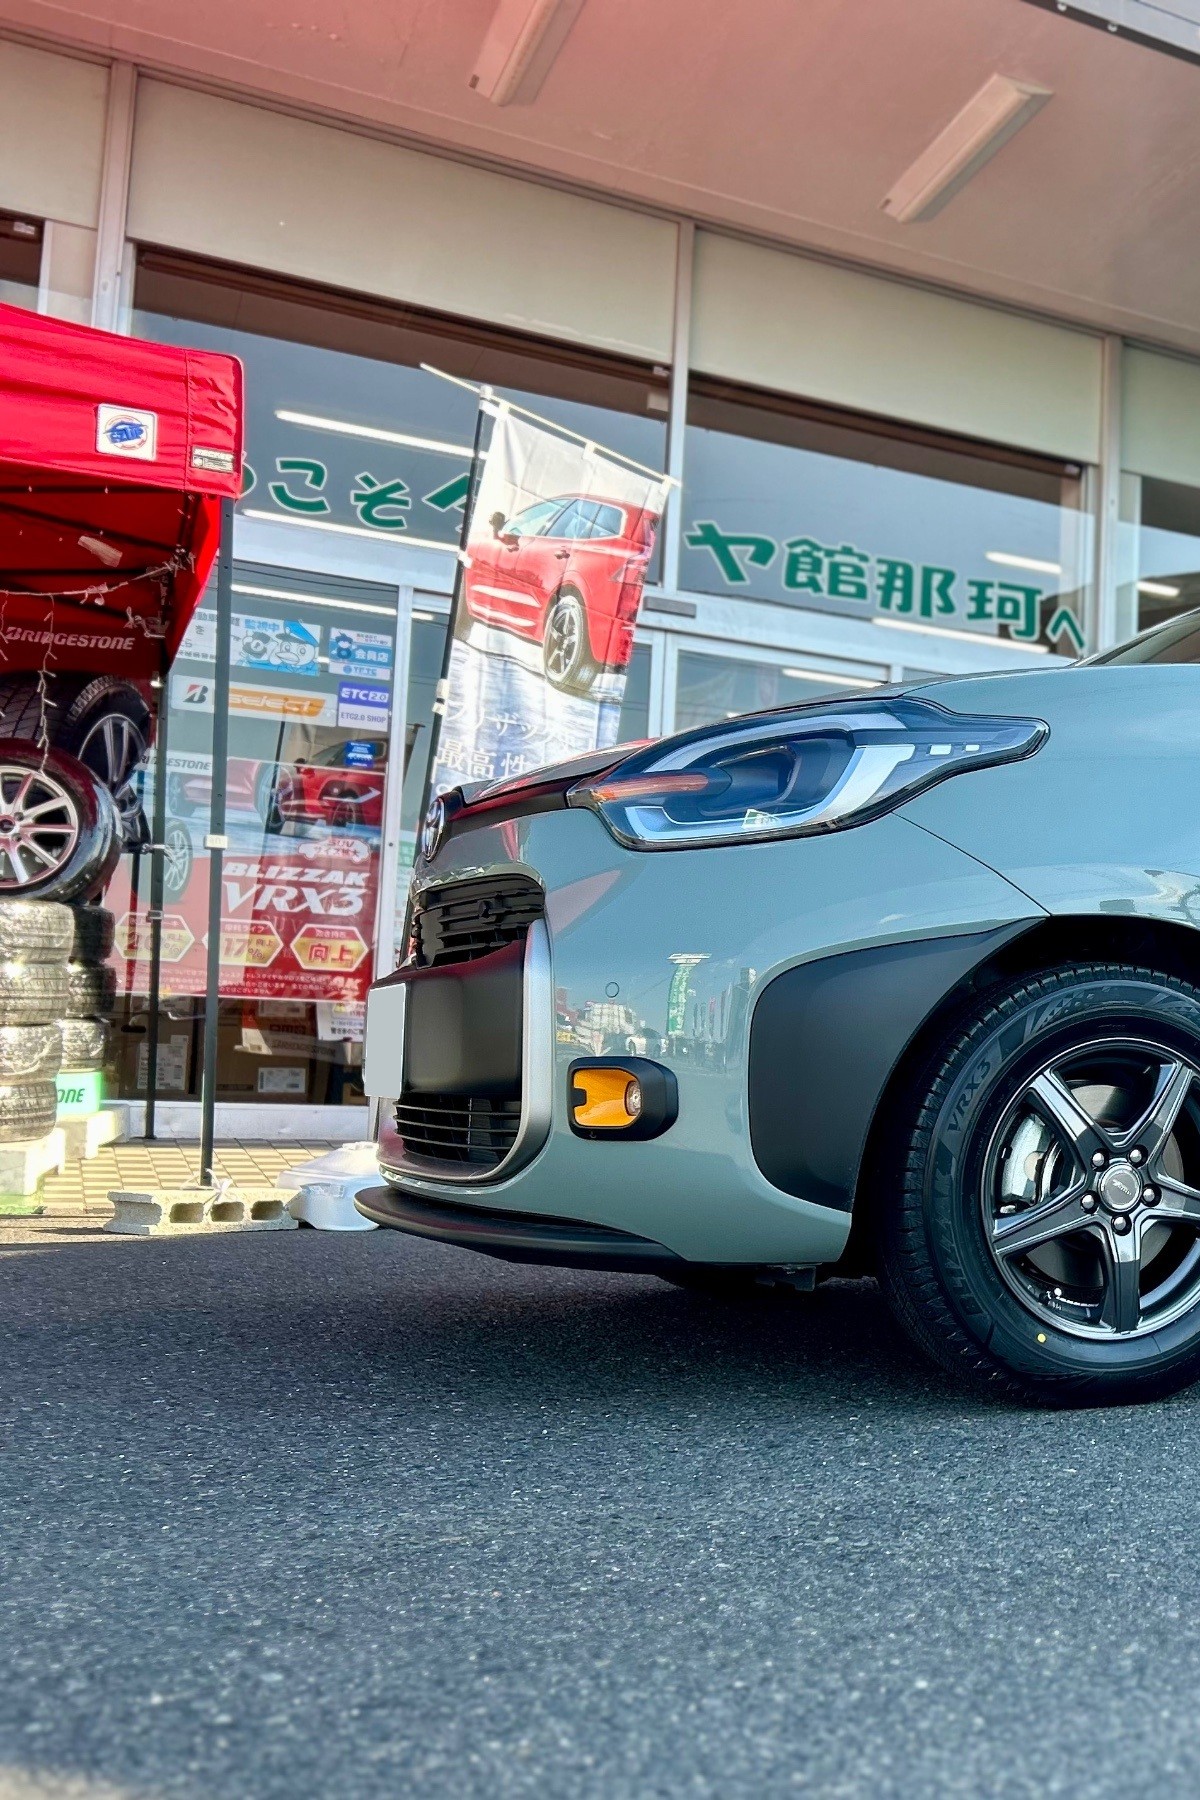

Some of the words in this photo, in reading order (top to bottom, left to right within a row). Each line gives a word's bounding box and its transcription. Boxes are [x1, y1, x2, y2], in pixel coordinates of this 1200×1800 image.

[683, 520, 1086, 652] ヤ館那珂へ
[6, 626, 135, 650] BRIDGESTONE
[366, 713, 387, 724] SHOP
[222, 862, 371, 887] BLIZZAK
[222, 880, 371, 916] VRX3
[307, 943, 355, 963] 向上
[948, 1057, 992, 1134] VRX3
